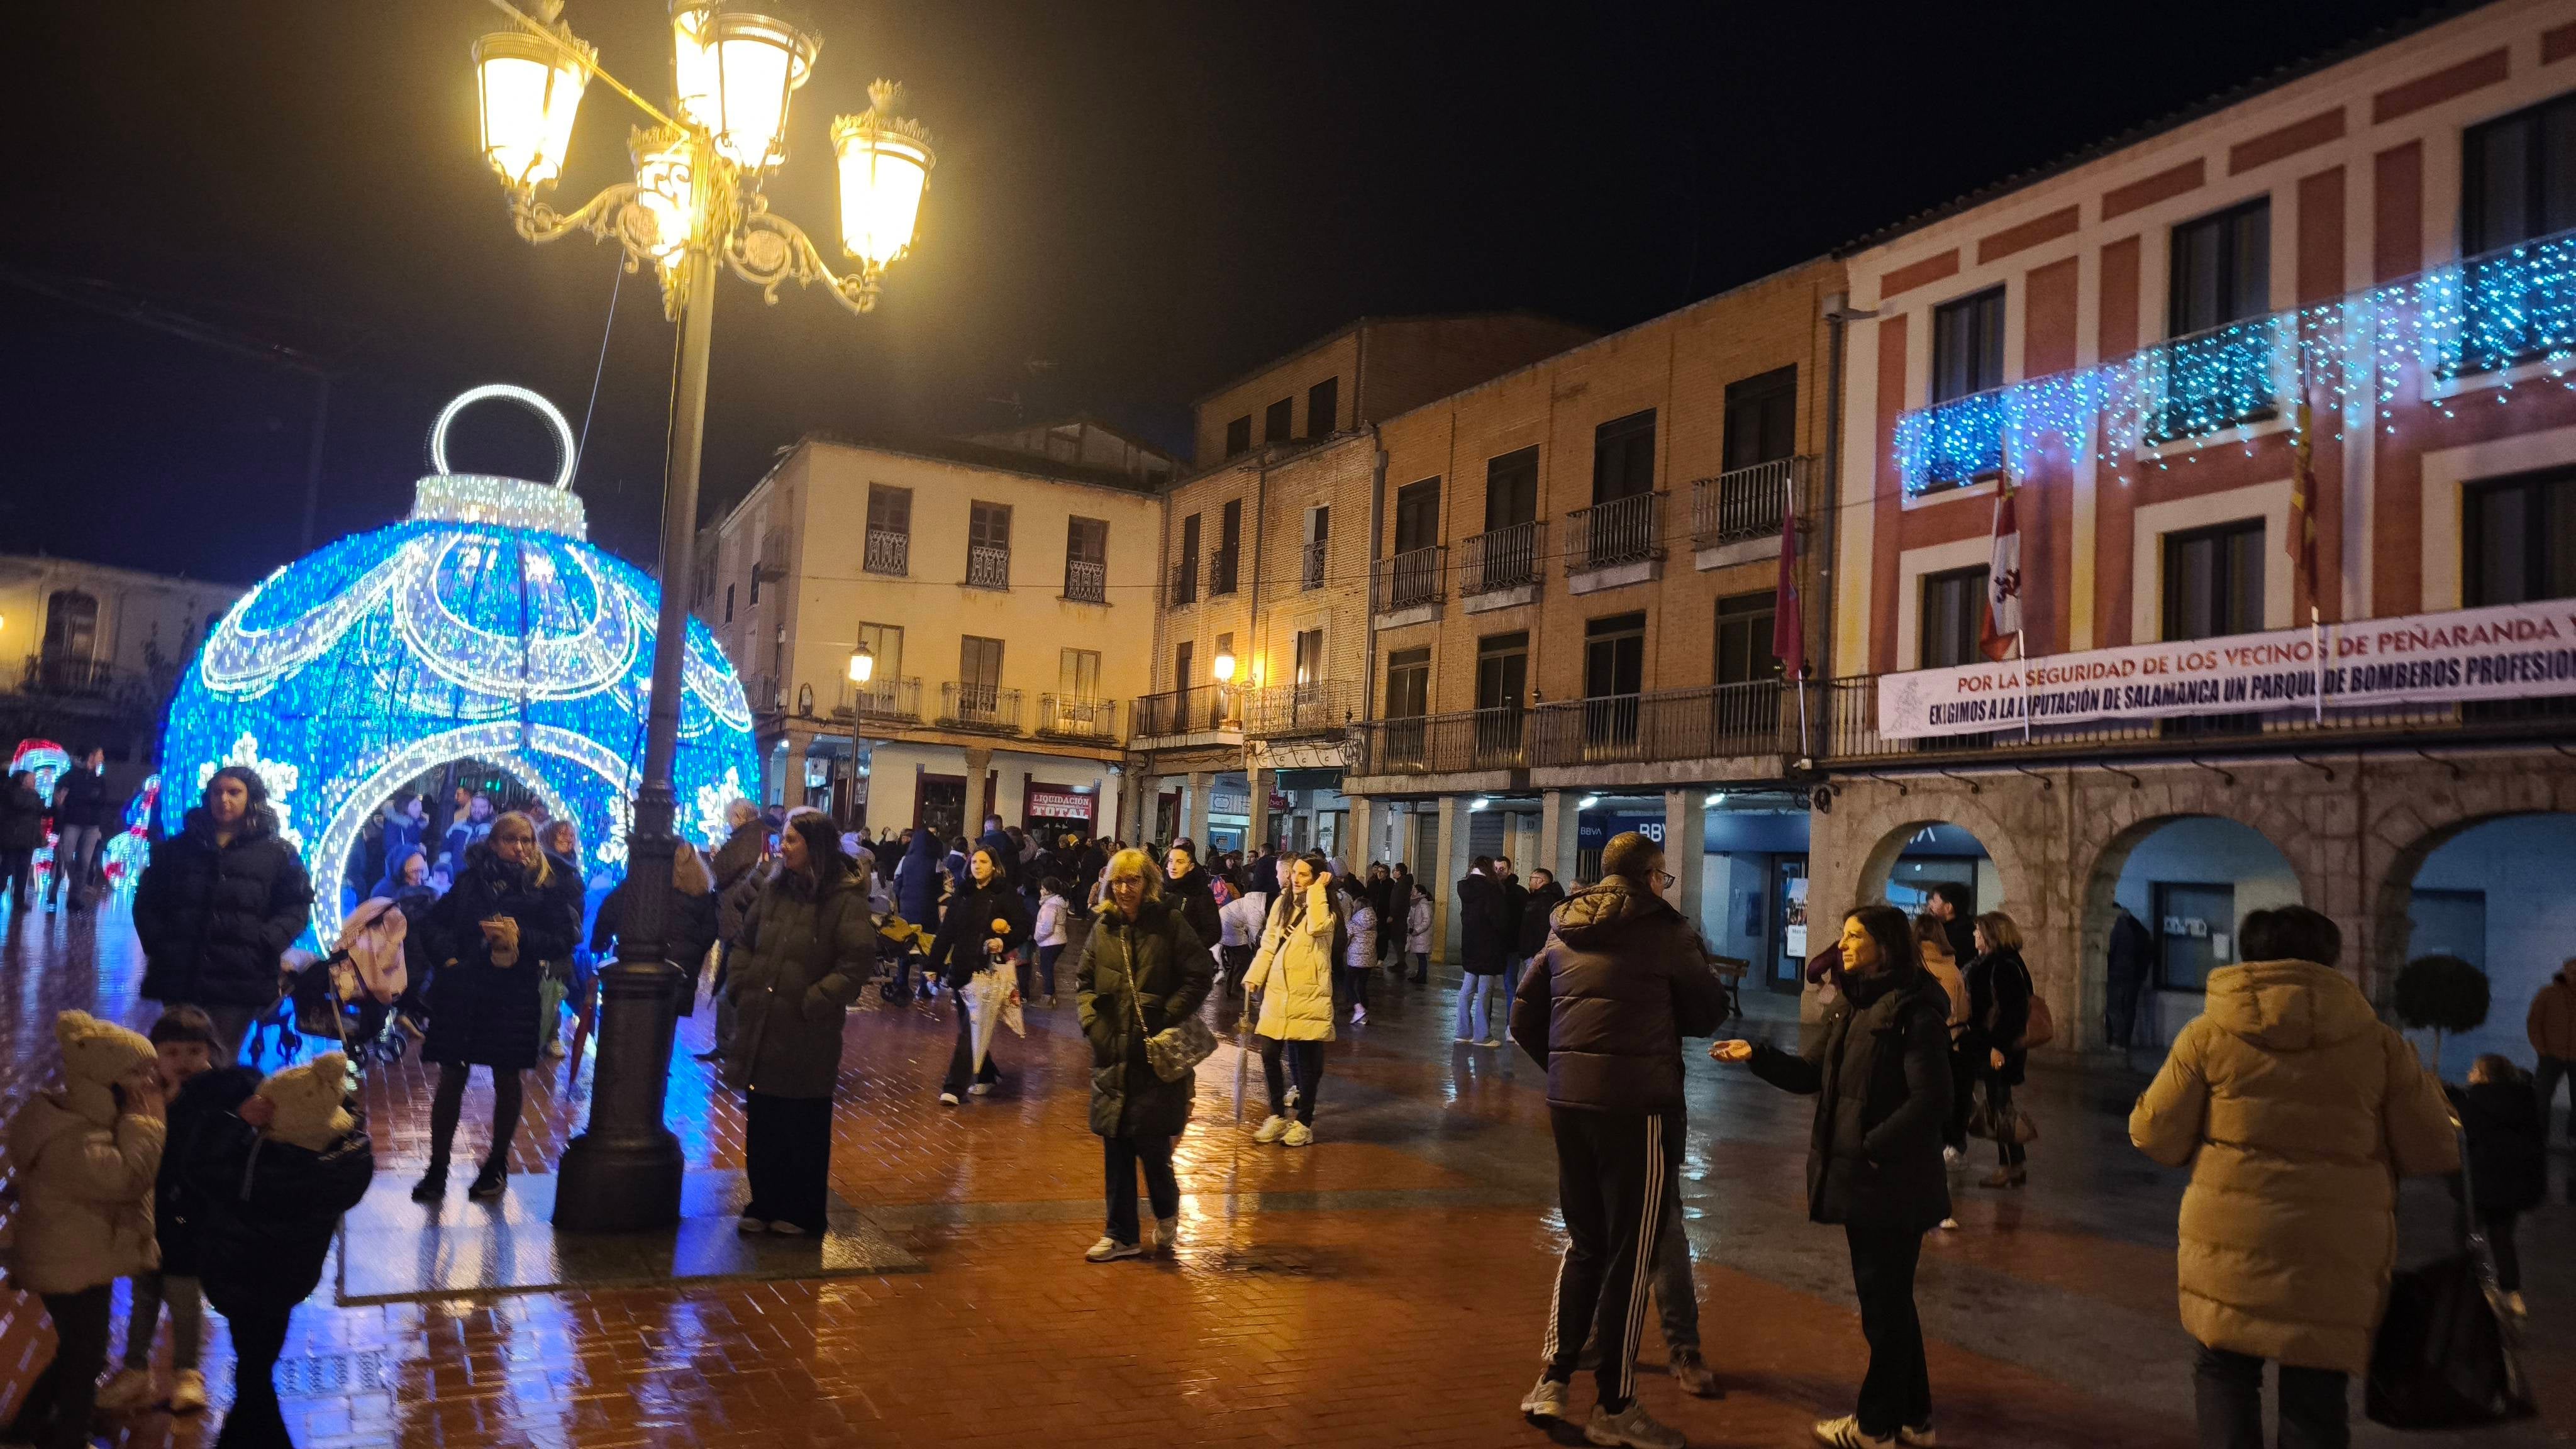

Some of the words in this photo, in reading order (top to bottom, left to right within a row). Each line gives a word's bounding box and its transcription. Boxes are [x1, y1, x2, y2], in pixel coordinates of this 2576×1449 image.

[1958, 675, 1993, 692] POR
[1998, 672, 2020, 689] LA
[2025, 659, 2136, 687] SEGURIDAD
[2143, 655, 2169, 675] DE
[2177, 650, 2219, 674] LOS
[2224, 638, 2329, 667] VECINOS
[2338, 635, 2370, 658] DE
[2377, 617, 2560, 654] PEÑARANDA
[1989, 699, 1997, 720] A
[1999, 696, 2014, 719] LA
[2102, 687, 2121, 711] DE
[2124, 678, 2219, 709] SALAMANCA
[2223, 675, 2247, 702] UN
[2323, 667, 2346, 695] DE
[2350, 657, 2462, 693] BOMBEROS
[1033, 794, 1089, 806] LIQUIDACIÓN
[1032, 805, 1089, 819] TOTAL
[1580, 826, 1602, 836] BBVA
